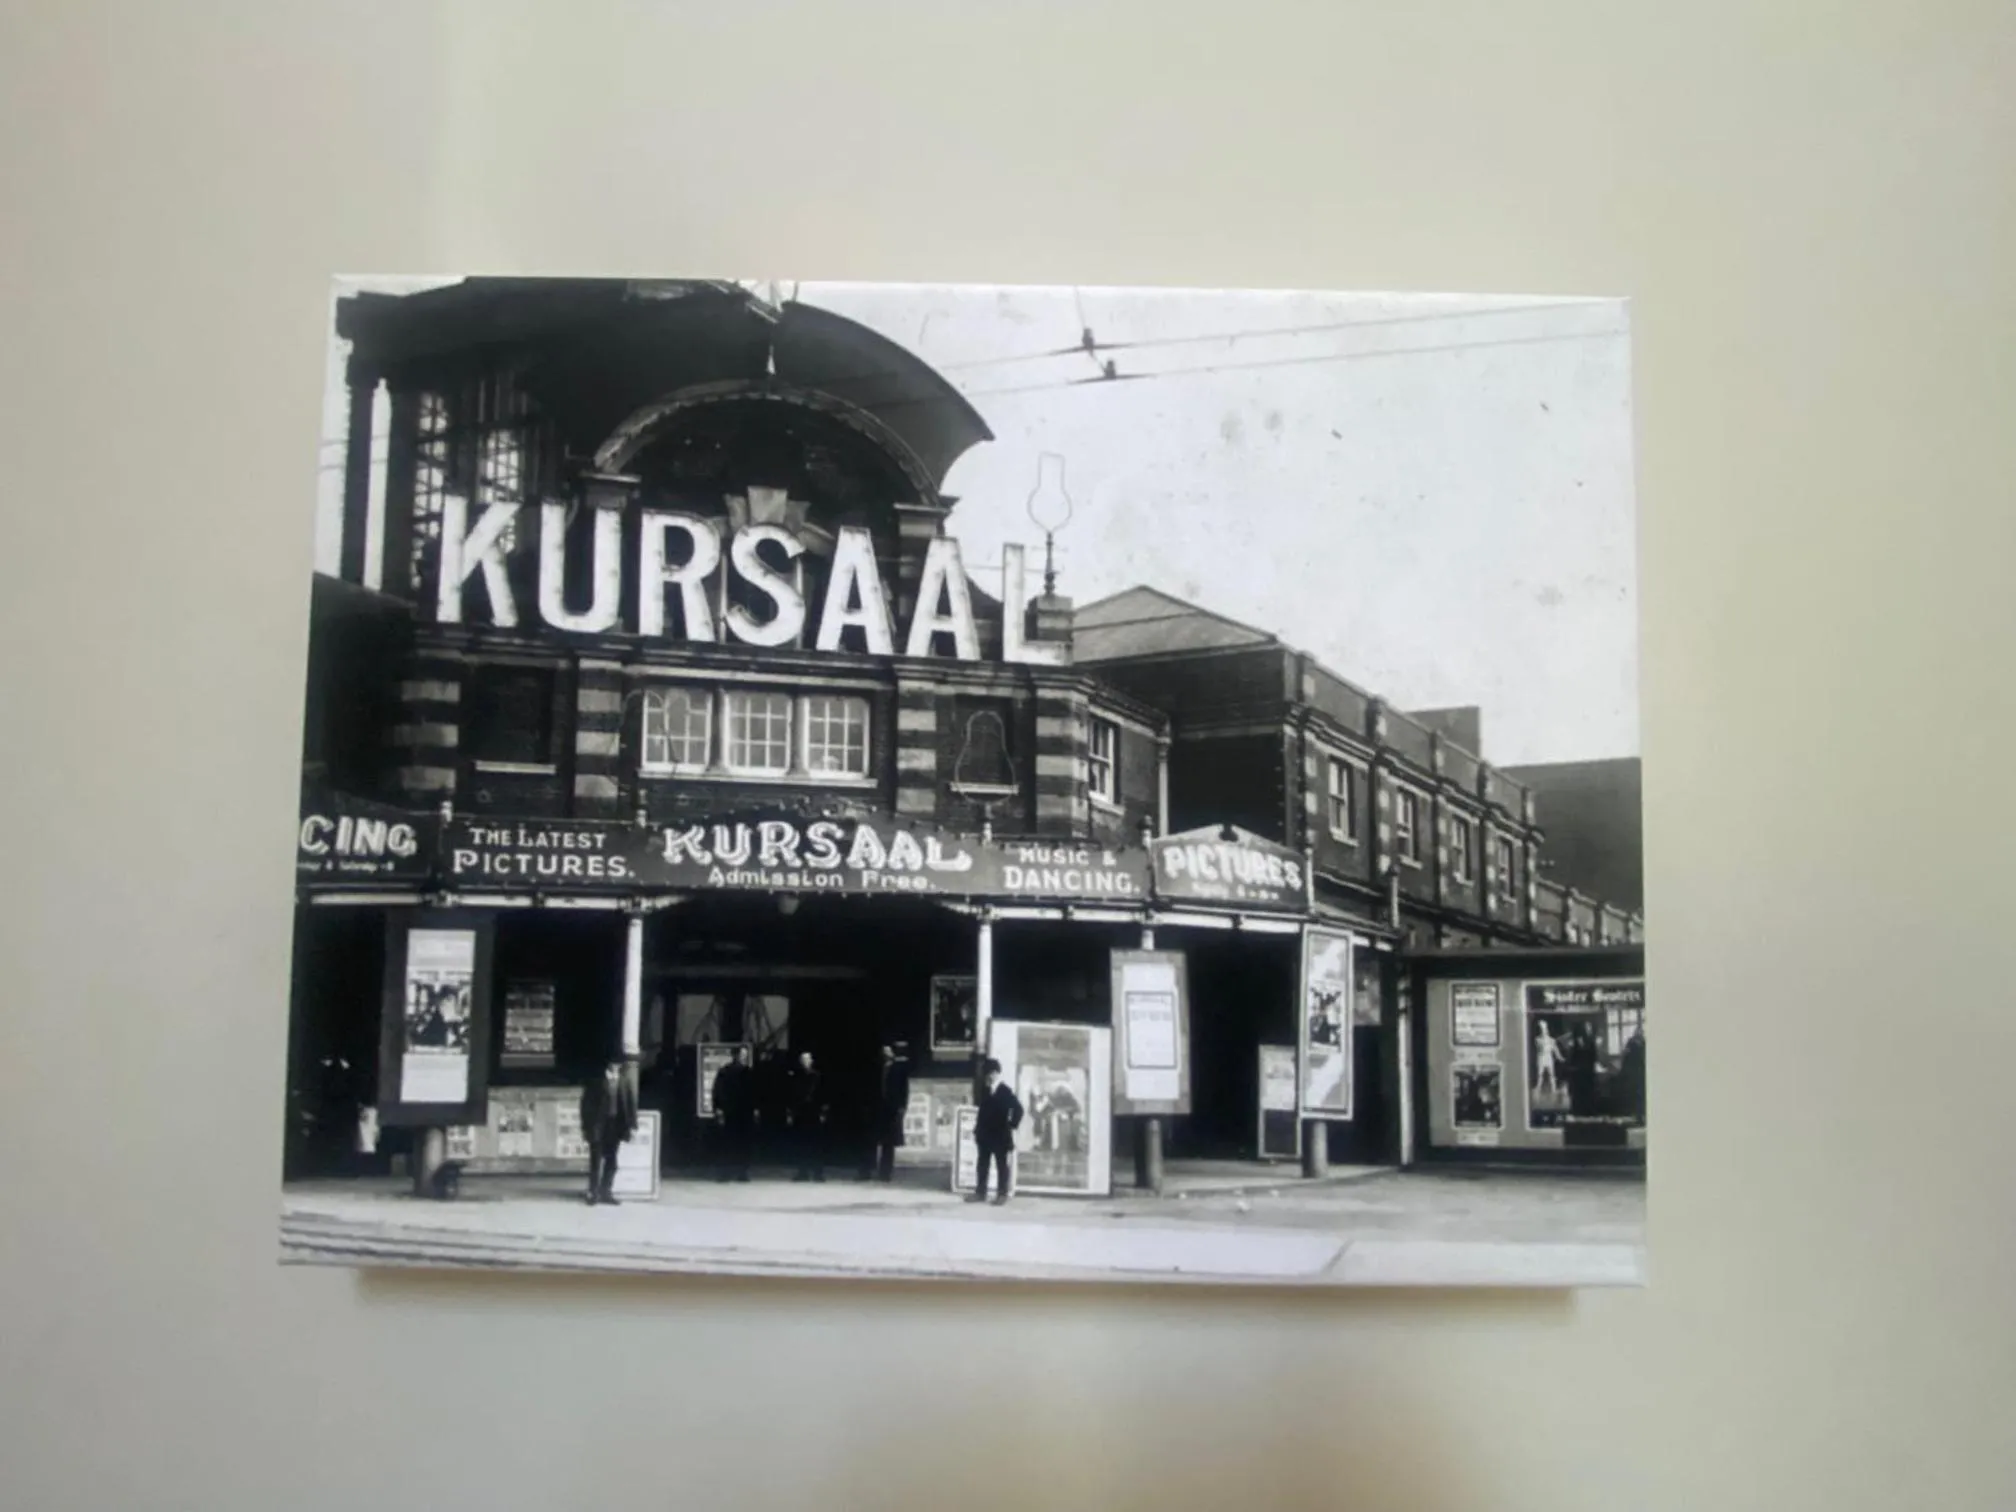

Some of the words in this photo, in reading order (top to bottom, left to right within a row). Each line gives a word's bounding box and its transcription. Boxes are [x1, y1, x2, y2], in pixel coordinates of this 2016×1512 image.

[437, 494, 1072, 666] KURSAAL
[300, 814, 418, 857] CING
[469, 827, 513, 846] THE
[517, 828, 607, 849] LATEST
[662, 820, 973, 872] KURSAAL
[452, 849, 636, 878] PICTURES.
[1018, 846, 1090, 866] MUSIC
[1102, 849, 1117, 866] &
[707, 865, 844, 888] Admission
[1003, 865, 1141, 895] DANCING.
